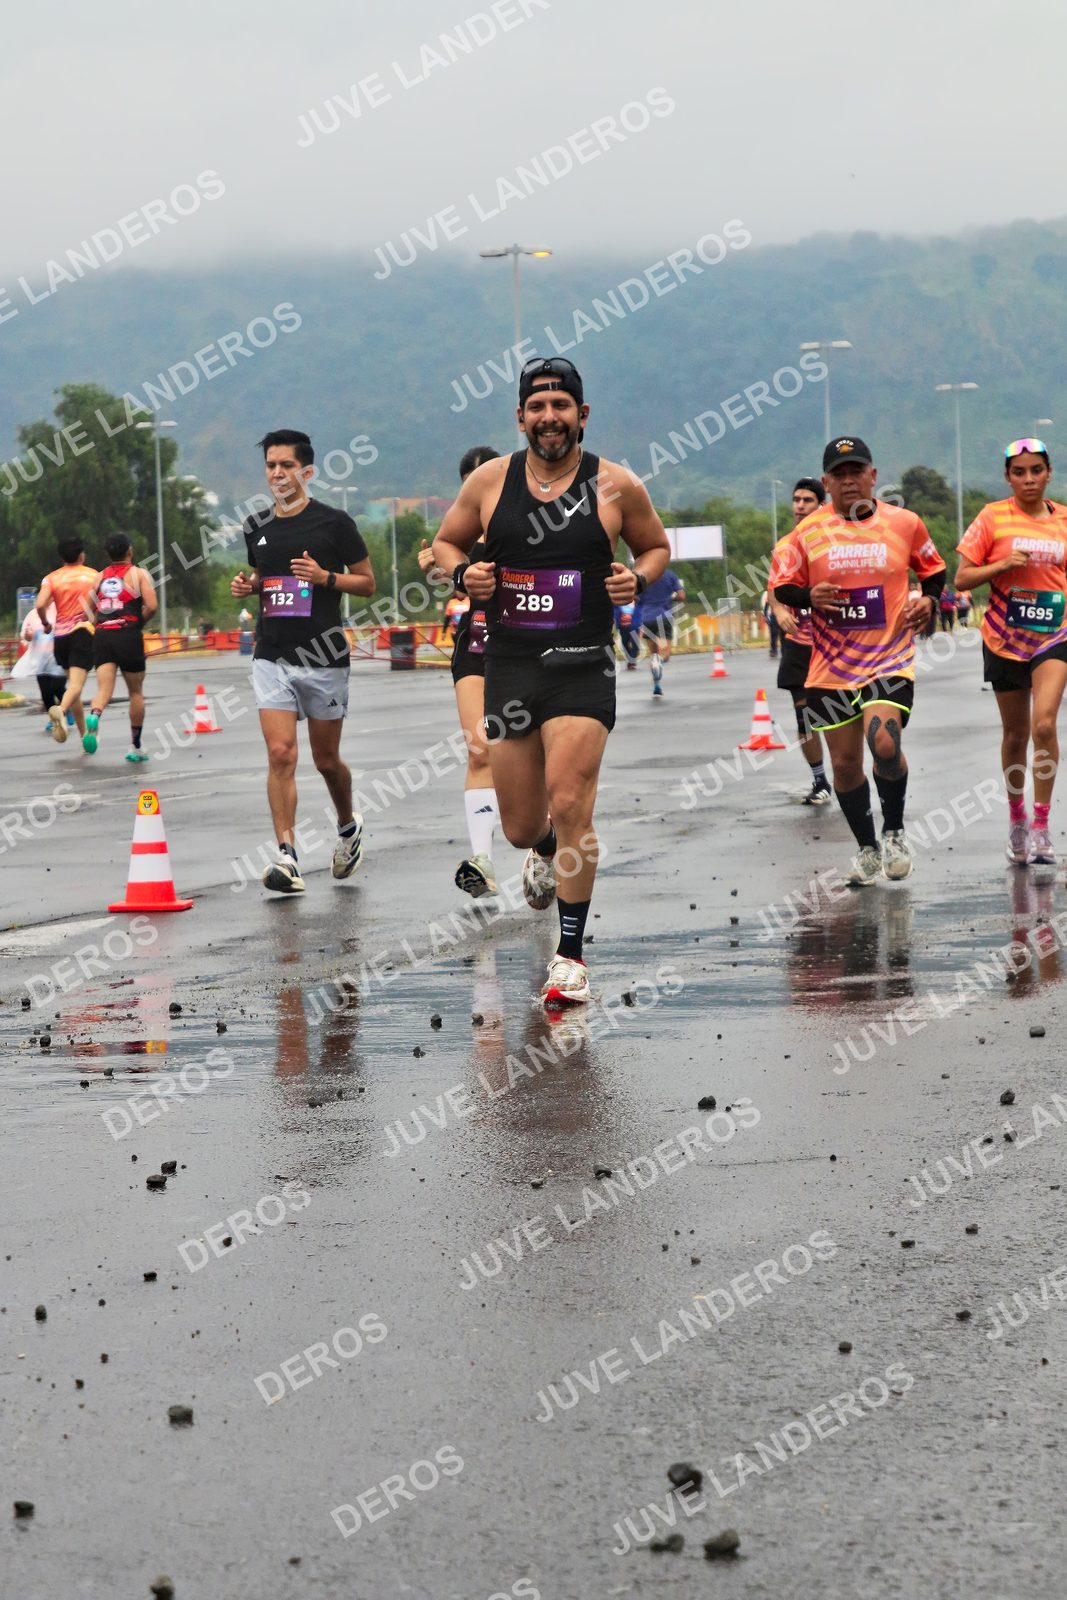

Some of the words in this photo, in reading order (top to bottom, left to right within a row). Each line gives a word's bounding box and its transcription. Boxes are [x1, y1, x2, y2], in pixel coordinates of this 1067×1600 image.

[828, 543, 887, 561] CARRERA
[270, 592, 295, 606] 132
[515, 593, 554, 612] 289
[840, 606, 867, 619] 143
[1019, 605, 1054, 620] 1695
